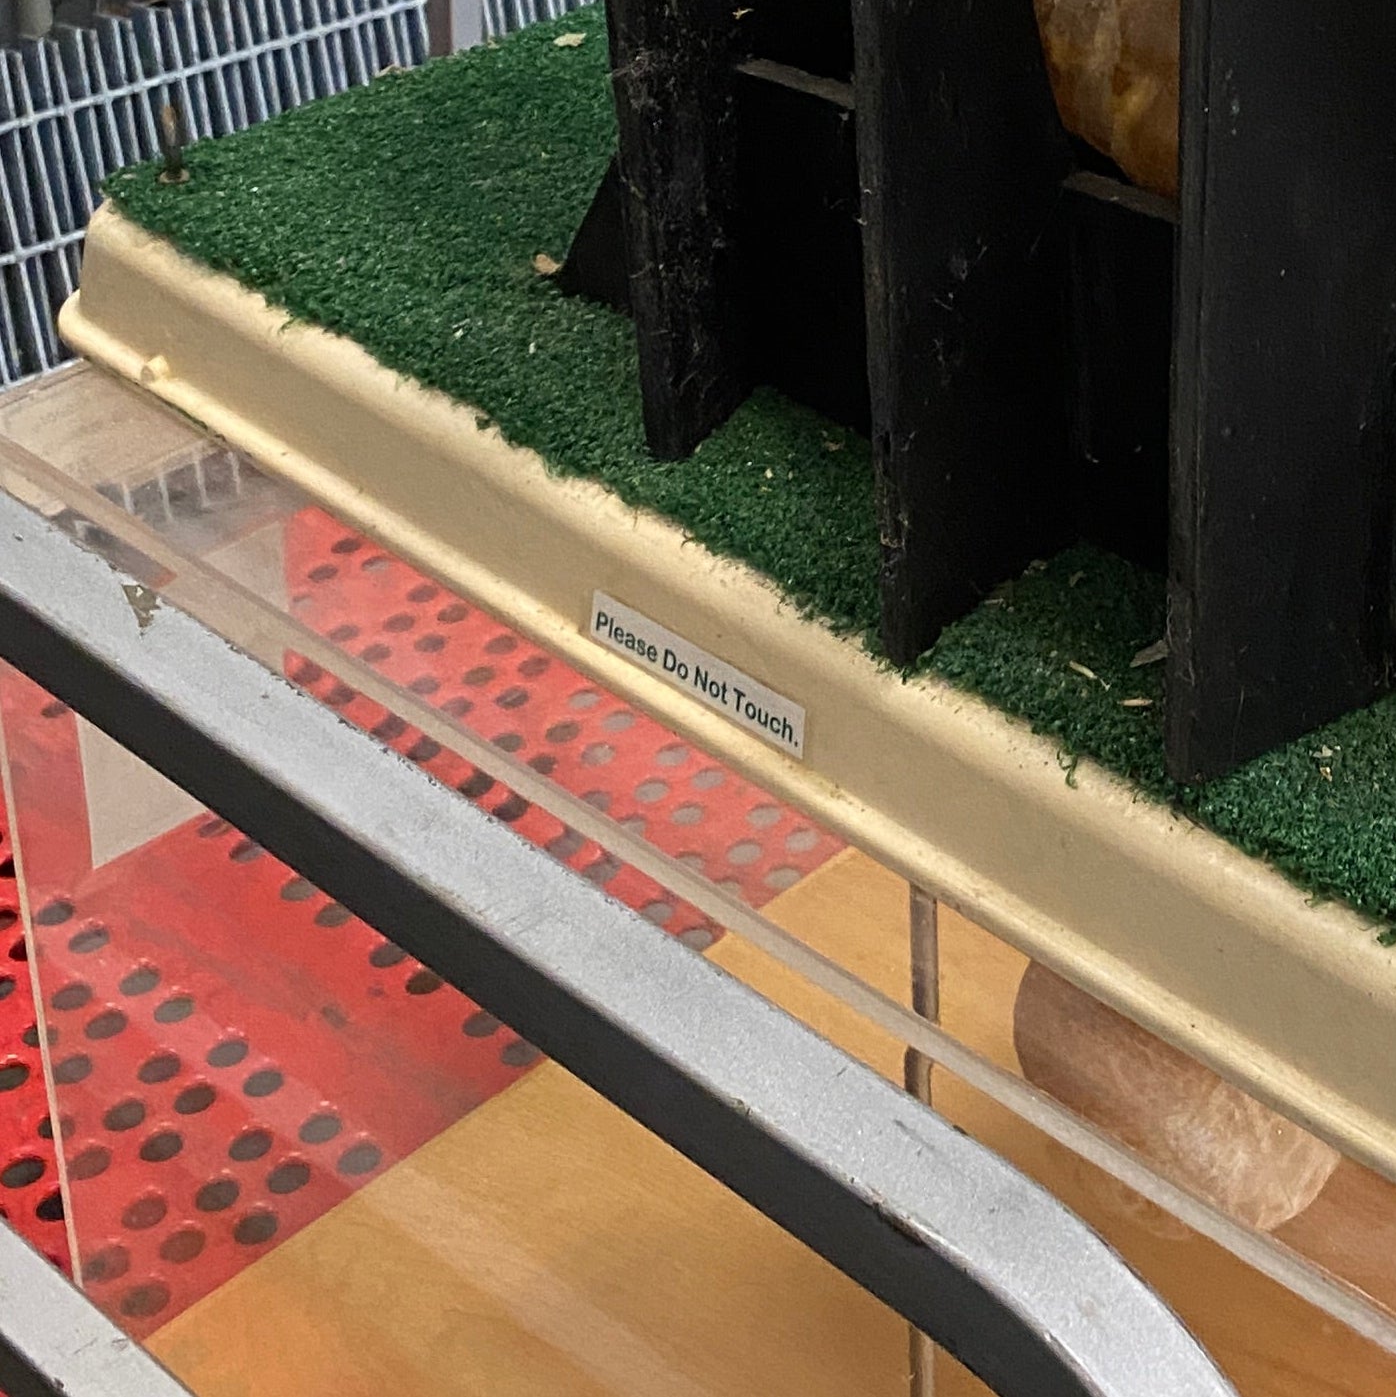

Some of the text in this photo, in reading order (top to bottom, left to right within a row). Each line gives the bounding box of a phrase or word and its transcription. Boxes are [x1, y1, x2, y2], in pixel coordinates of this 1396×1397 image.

[595, 610, 798, 747] Please Do Not Touch.
